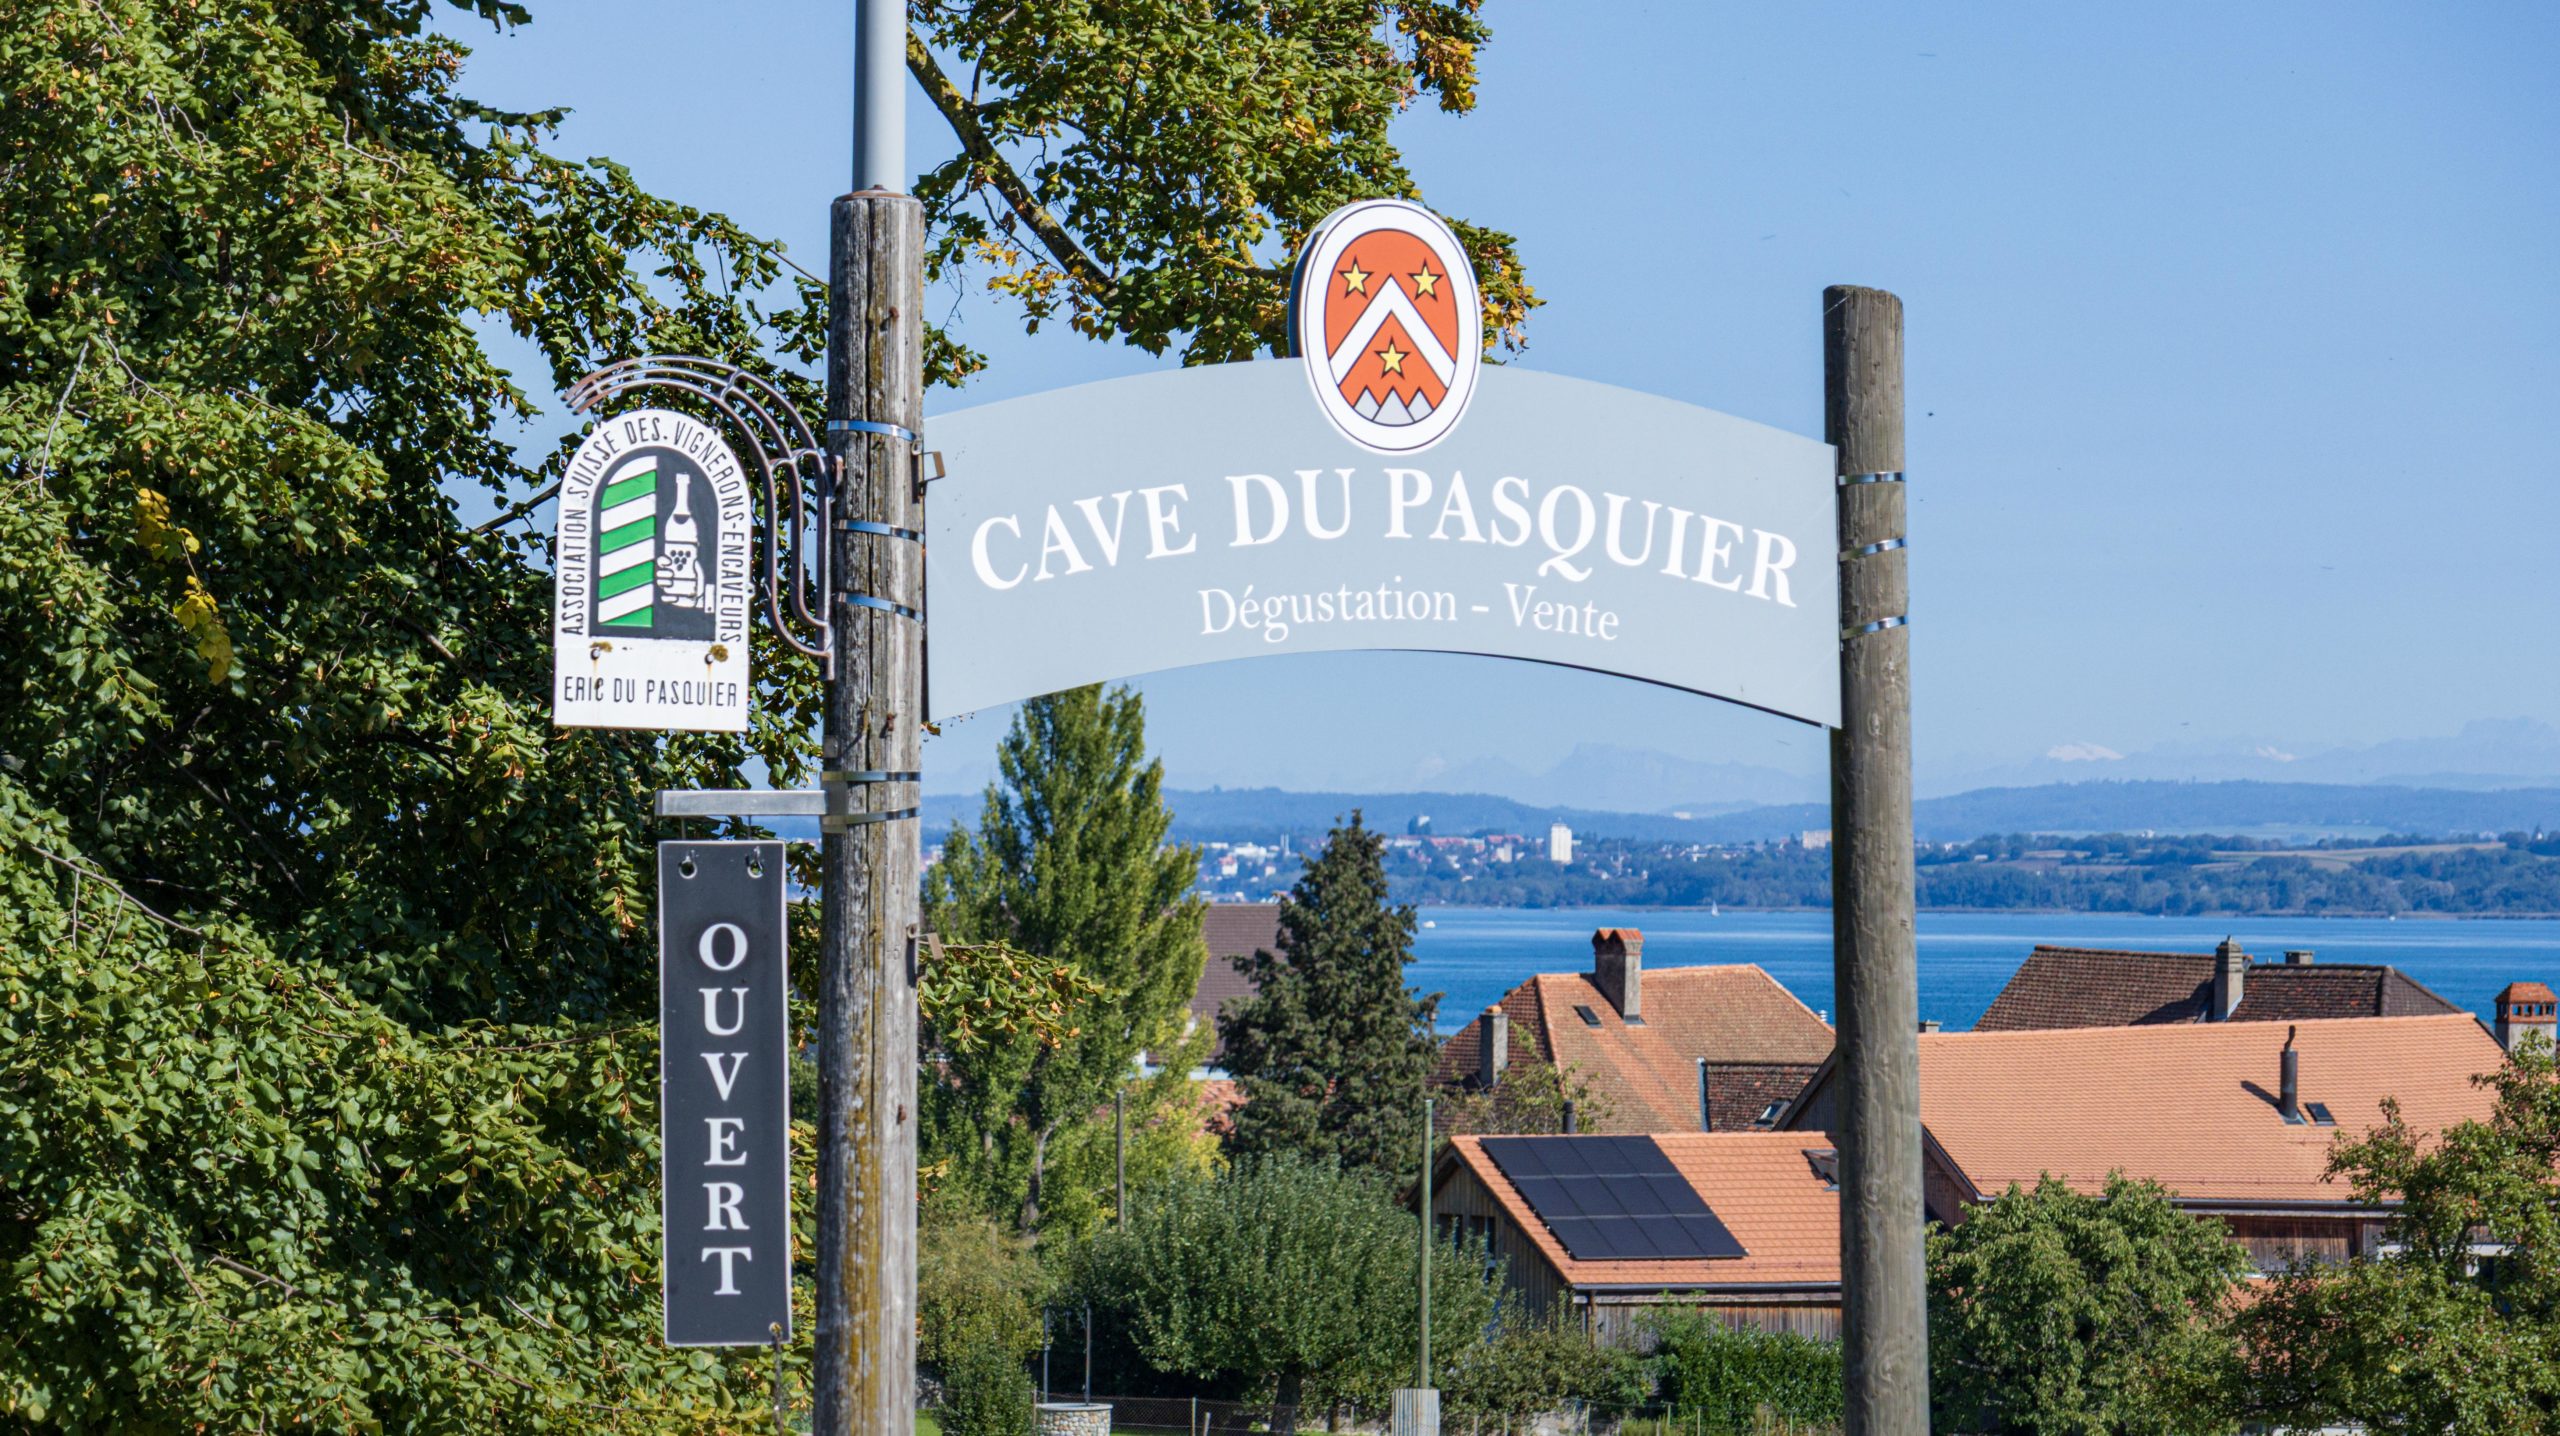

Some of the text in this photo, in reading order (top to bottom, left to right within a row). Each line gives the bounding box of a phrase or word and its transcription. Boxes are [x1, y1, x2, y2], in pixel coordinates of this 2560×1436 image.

[567, 430, 621, 499] SUISSE
[561, 508, 588, 636] ASSOCIATION
[971, 467, 1798, 608] CAVE DU PASQUIER
[1198, 574, 1458, 644] Dégustation
[1503, 582, 1620, 640] Vente
[564, 676, 738, 707] ERIC DU PASQUIER
[698, 922, 752, 1296] OUVERT
